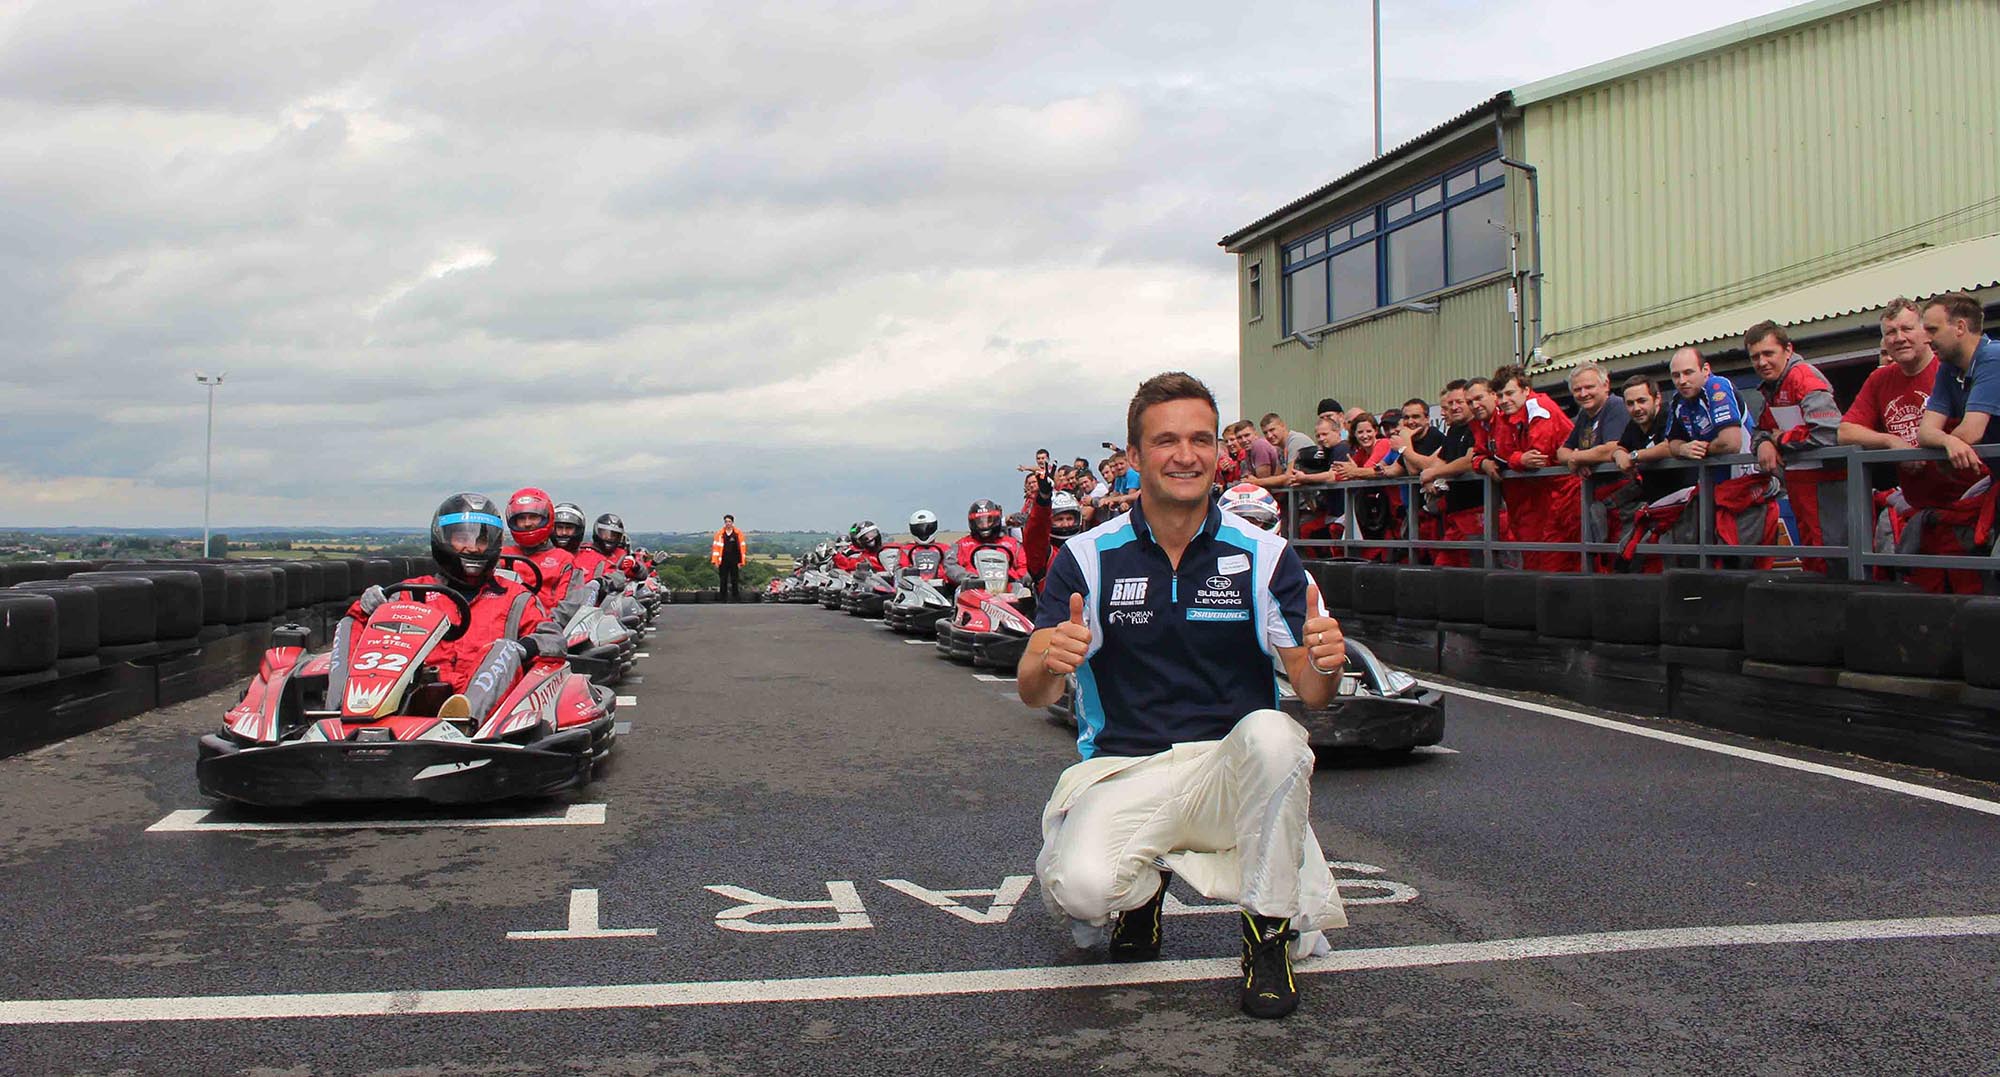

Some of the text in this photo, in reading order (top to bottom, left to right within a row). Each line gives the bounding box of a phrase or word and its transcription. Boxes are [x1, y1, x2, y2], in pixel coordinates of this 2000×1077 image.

[1111, 582, 1148, 600] BMR
[1197, 589, 1240, 597] SUBARU
[1194, 597, 1242, 605] LEVORG
[1125, 610, 1153, 619] ADRIAN
[382, 639, 412, 649] STEEL
[354, 652, 408, 672] 32
